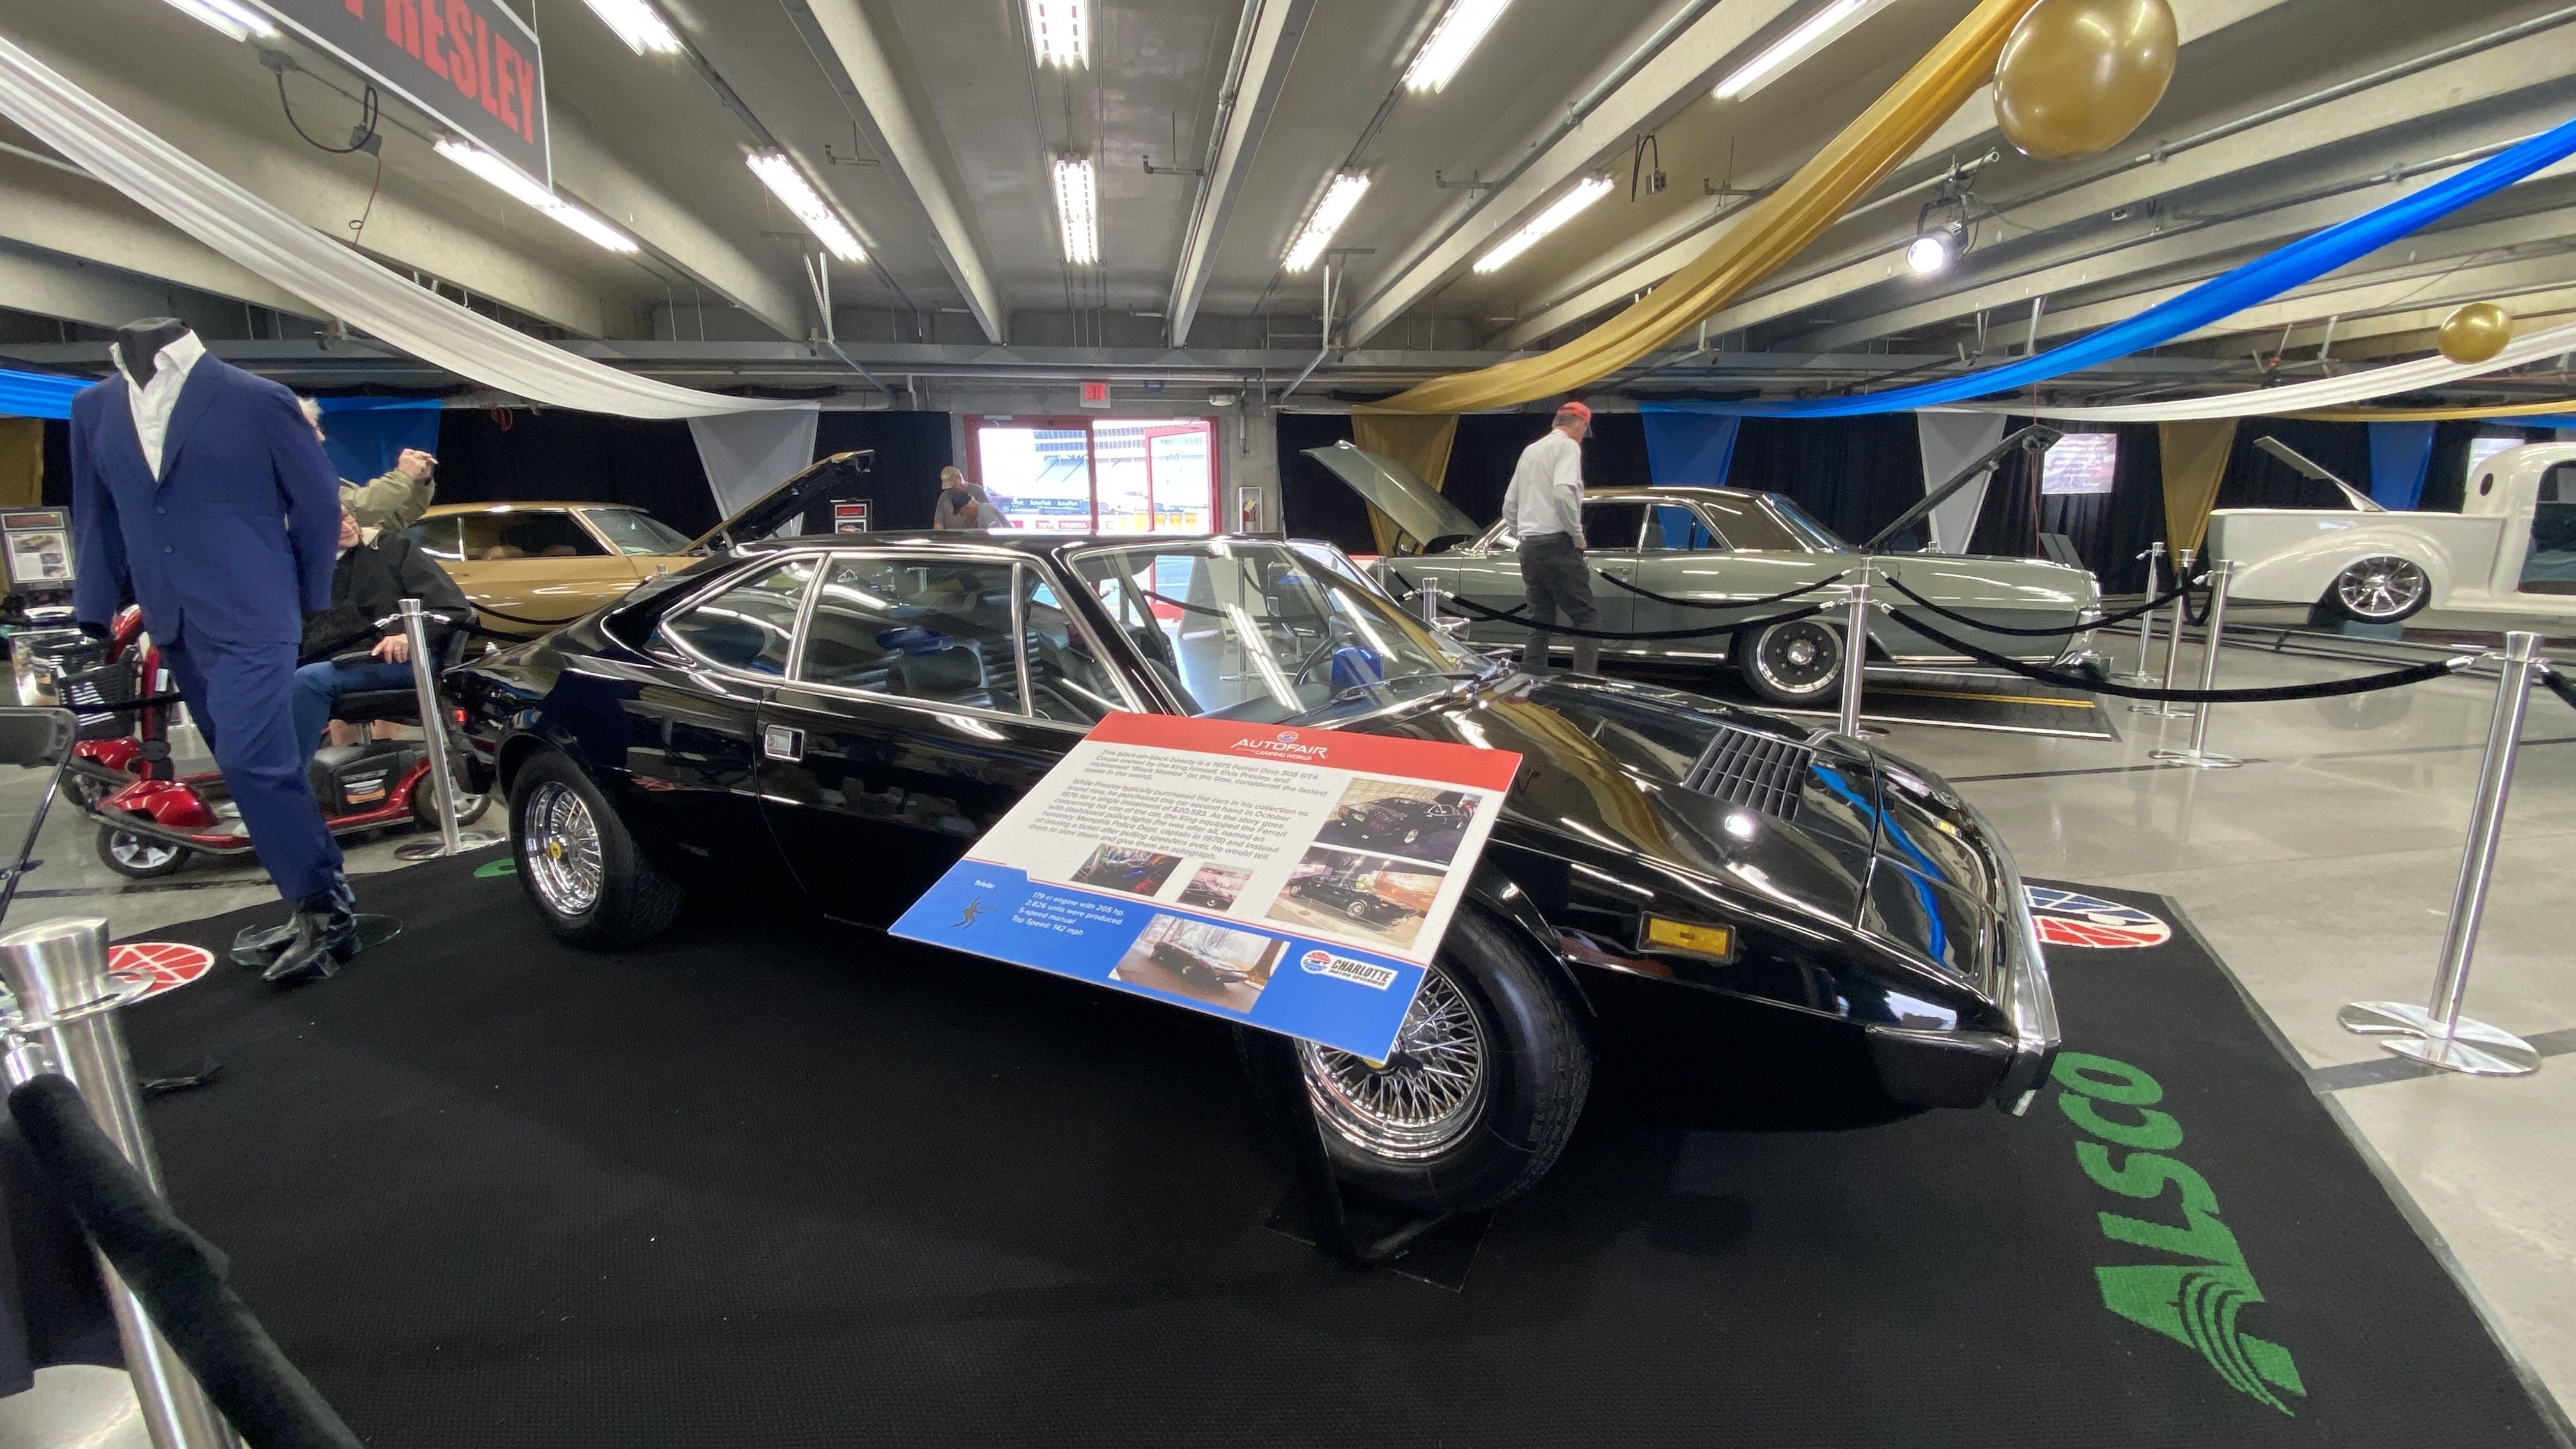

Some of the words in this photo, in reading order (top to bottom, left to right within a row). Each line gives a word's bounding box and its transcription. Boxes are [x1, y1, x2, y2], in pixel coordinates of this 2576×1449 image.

[344, 0, 533, 145] RESLEY
[1085, 383, 1105, 401] EXIT
[1229, 738, 1328, 760] AUTOFAIR
[1254, 749, 1286, 758] CAMPING
[1286, 753, 1312, 761] WORLD
[1169, 756, 1197, 765] beauty
[1231, 763, 1260, 772] Ferrari
[1169, 763, 1188, 772] King
[1089, 761, 1130, 770] nicknamed
[1234, 779, 1282, 790] considered
[1298, 786, 1328, 797] fastest
[1073, 778, 1094, 786] While
[1093, 781, 1123, 791] Presley
[1122, 785, 1154, 795] typically
[1153, 790, 1197, 800] purchased
[1254, 804, 1296, 815] collection
[1117, 792, 1160, 802] purchased
[1189, 802, 1222, 811] second
[1221, 806, 1244, 815] hand
[1254, 811, 1291, 822] October
[1054, 798, 1096, 809] concerning
[1177, 815, 1198, 824] King
[1199, 819, 1241, 830] equipped
[1256, 827, 1288, 838] Ferrari
[1064, 806, 1106, 816] dashboard
[1103, 813, 1130, 821] police
[1130, 815, 1153, 824] lights
[1220, 831, 1253, 840] named
[1096, 796, 1120, 804] single
[1238, 817, 1261, 826] story
[1028, 824, 1048, 832] them
[1057, 827, 1077, 836] slow
[1077, 831, 1100, 839] down
[1135, 840, 1157, 849] them
[1170, 847, 1216, 860] autograph.
[1041, 809, 1075, 821] honorary
[1075, 815, 1111, 825] Memphis
[1110, 820, 1136, 829] Police
[1160, 829, 1191, 838] captain
[1202, 834, 1226, 845] 1976)
[1245, 841, 1280, 853] instead
[1043, 817, 1071, 829] issuing
[1078, 822, 1100, 832] ticket
[1119, 830, 1148, 840] pulling
[1147, 835, 1188, 846] speeders
[1211, 844, 1223, 852] he
[1225, 848, 1254, 857] would
[1254, 852, 1269, 860] tell
[974, 880, 996, 889] Trivia:
[1018, 907, 1049, 919] 5-speed
[1047, 914, 1077, 924] manual
[1046, 905, 1066, 913] units
[1066, 908, 1085, 917] were
[1084, 913, 1123, 925] produced
[1052, 897, 1078, 906] engine
[1095, 904, 1113, 913] 205
[1011, 914, 1025, 924] Top
[1025, 917, 1052, 928] Speed:
[1052, 924, 1066, 932] 142
[1066, 928, 1084, 936] mph
[1328, 969, 1351, 977] MOTOR
[1351, 974, 1386, 986] SPEEDWAY
[1331, 959, 1392, 983] CHARLOTTE
[2050, 1050, 2308, 1418] ALSCO
